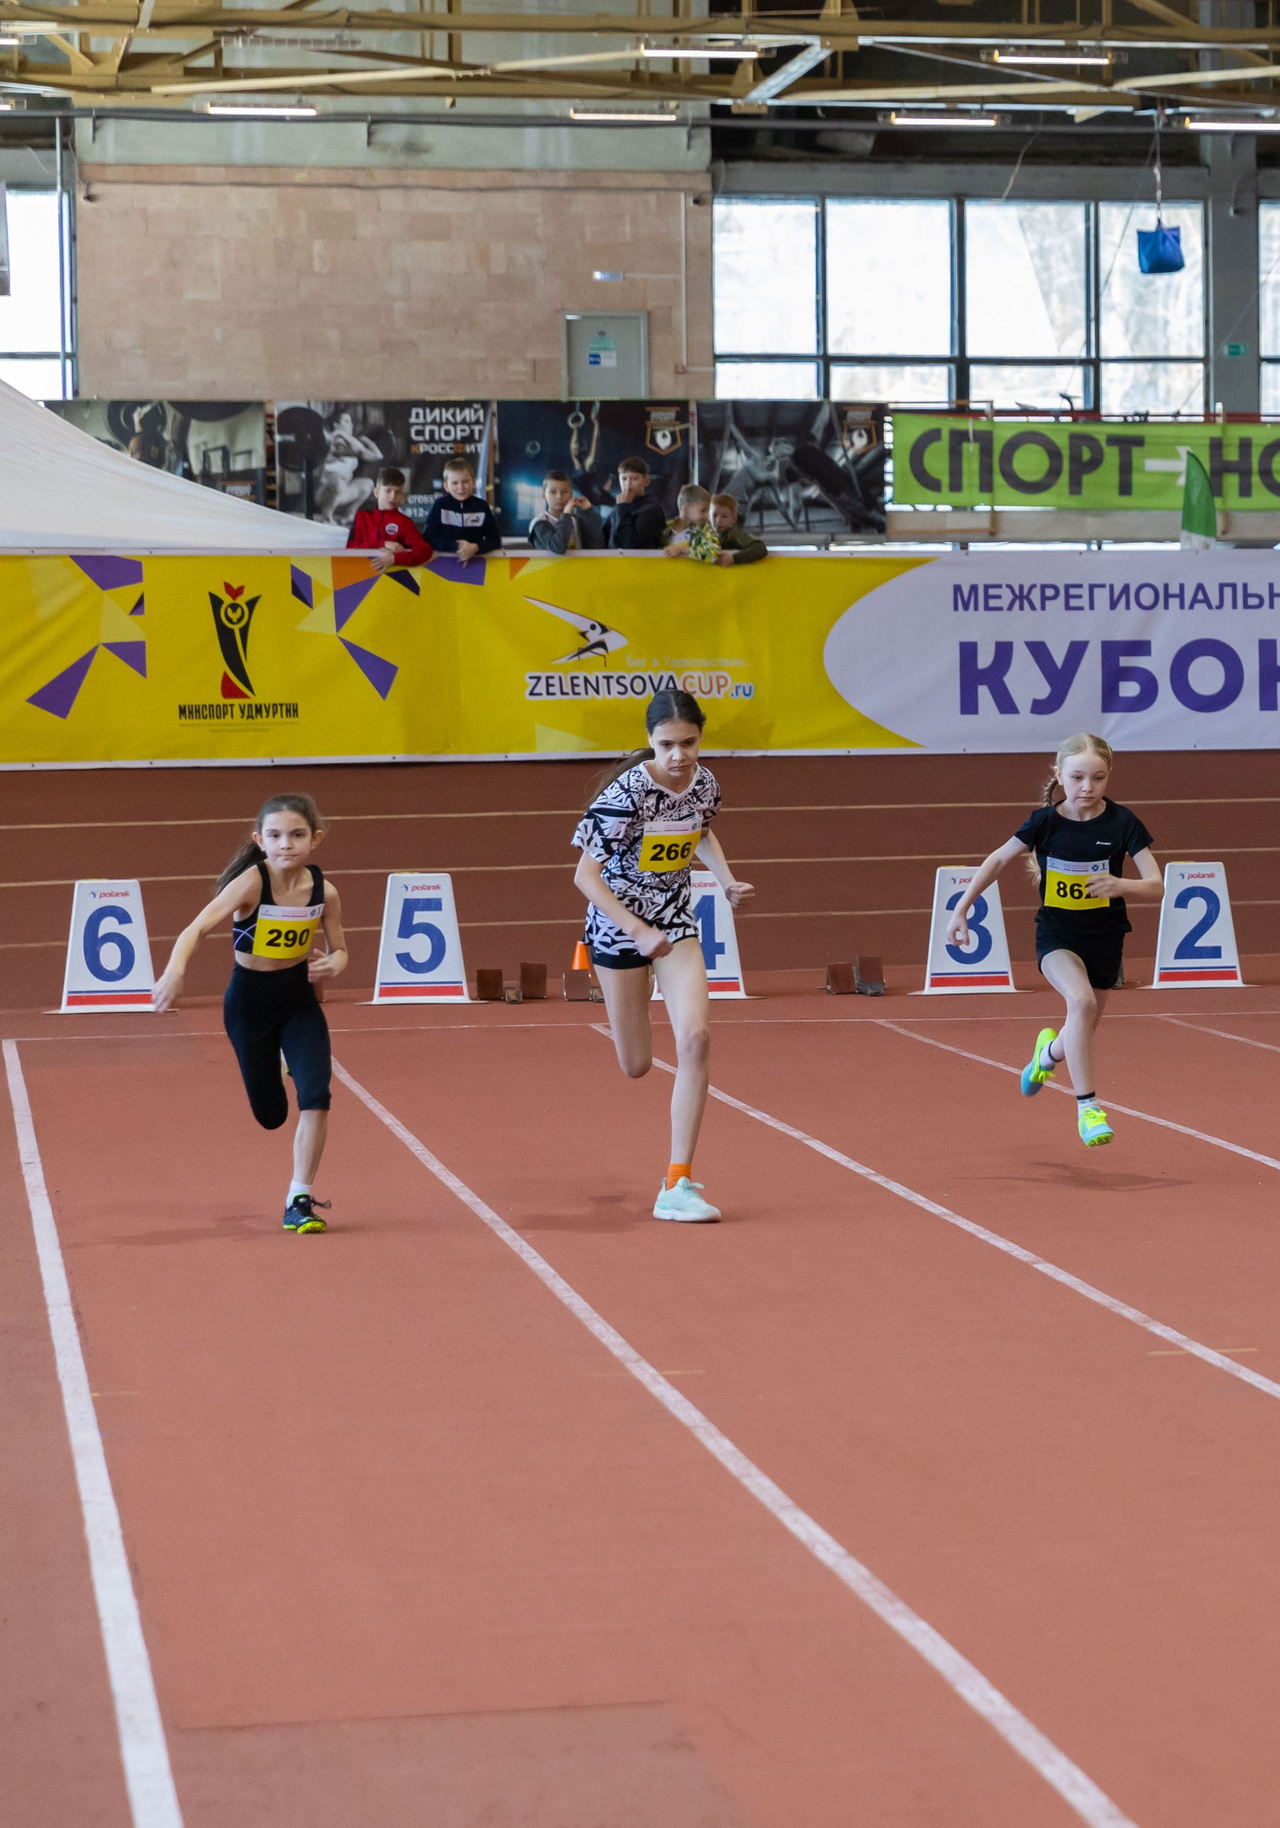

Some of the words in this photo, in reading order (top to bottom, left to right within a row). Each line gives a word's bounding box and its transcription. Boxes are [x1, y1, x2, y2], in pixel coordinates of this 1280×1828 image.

[410, 403, 484, 423] ДИКИЙ
[411, 424, 484, 441] СПОРТ
[909, 427, 1145, 496] СПОРТ
[649, 841, 692, 862] 266
[1187, 872, 1216, 880] polanik
[99, 890, 131, 899] polanik
[411, 883, 442, 892] polanik
[692, 895, 725, 970] 4
[945, 890, 992, 965] 3
[1174, 886, 1222, 960] 2
[83, 905, 135, 982] 6
[265, 928, 310, 948] 290
[395, 898, 446, 974] 5
